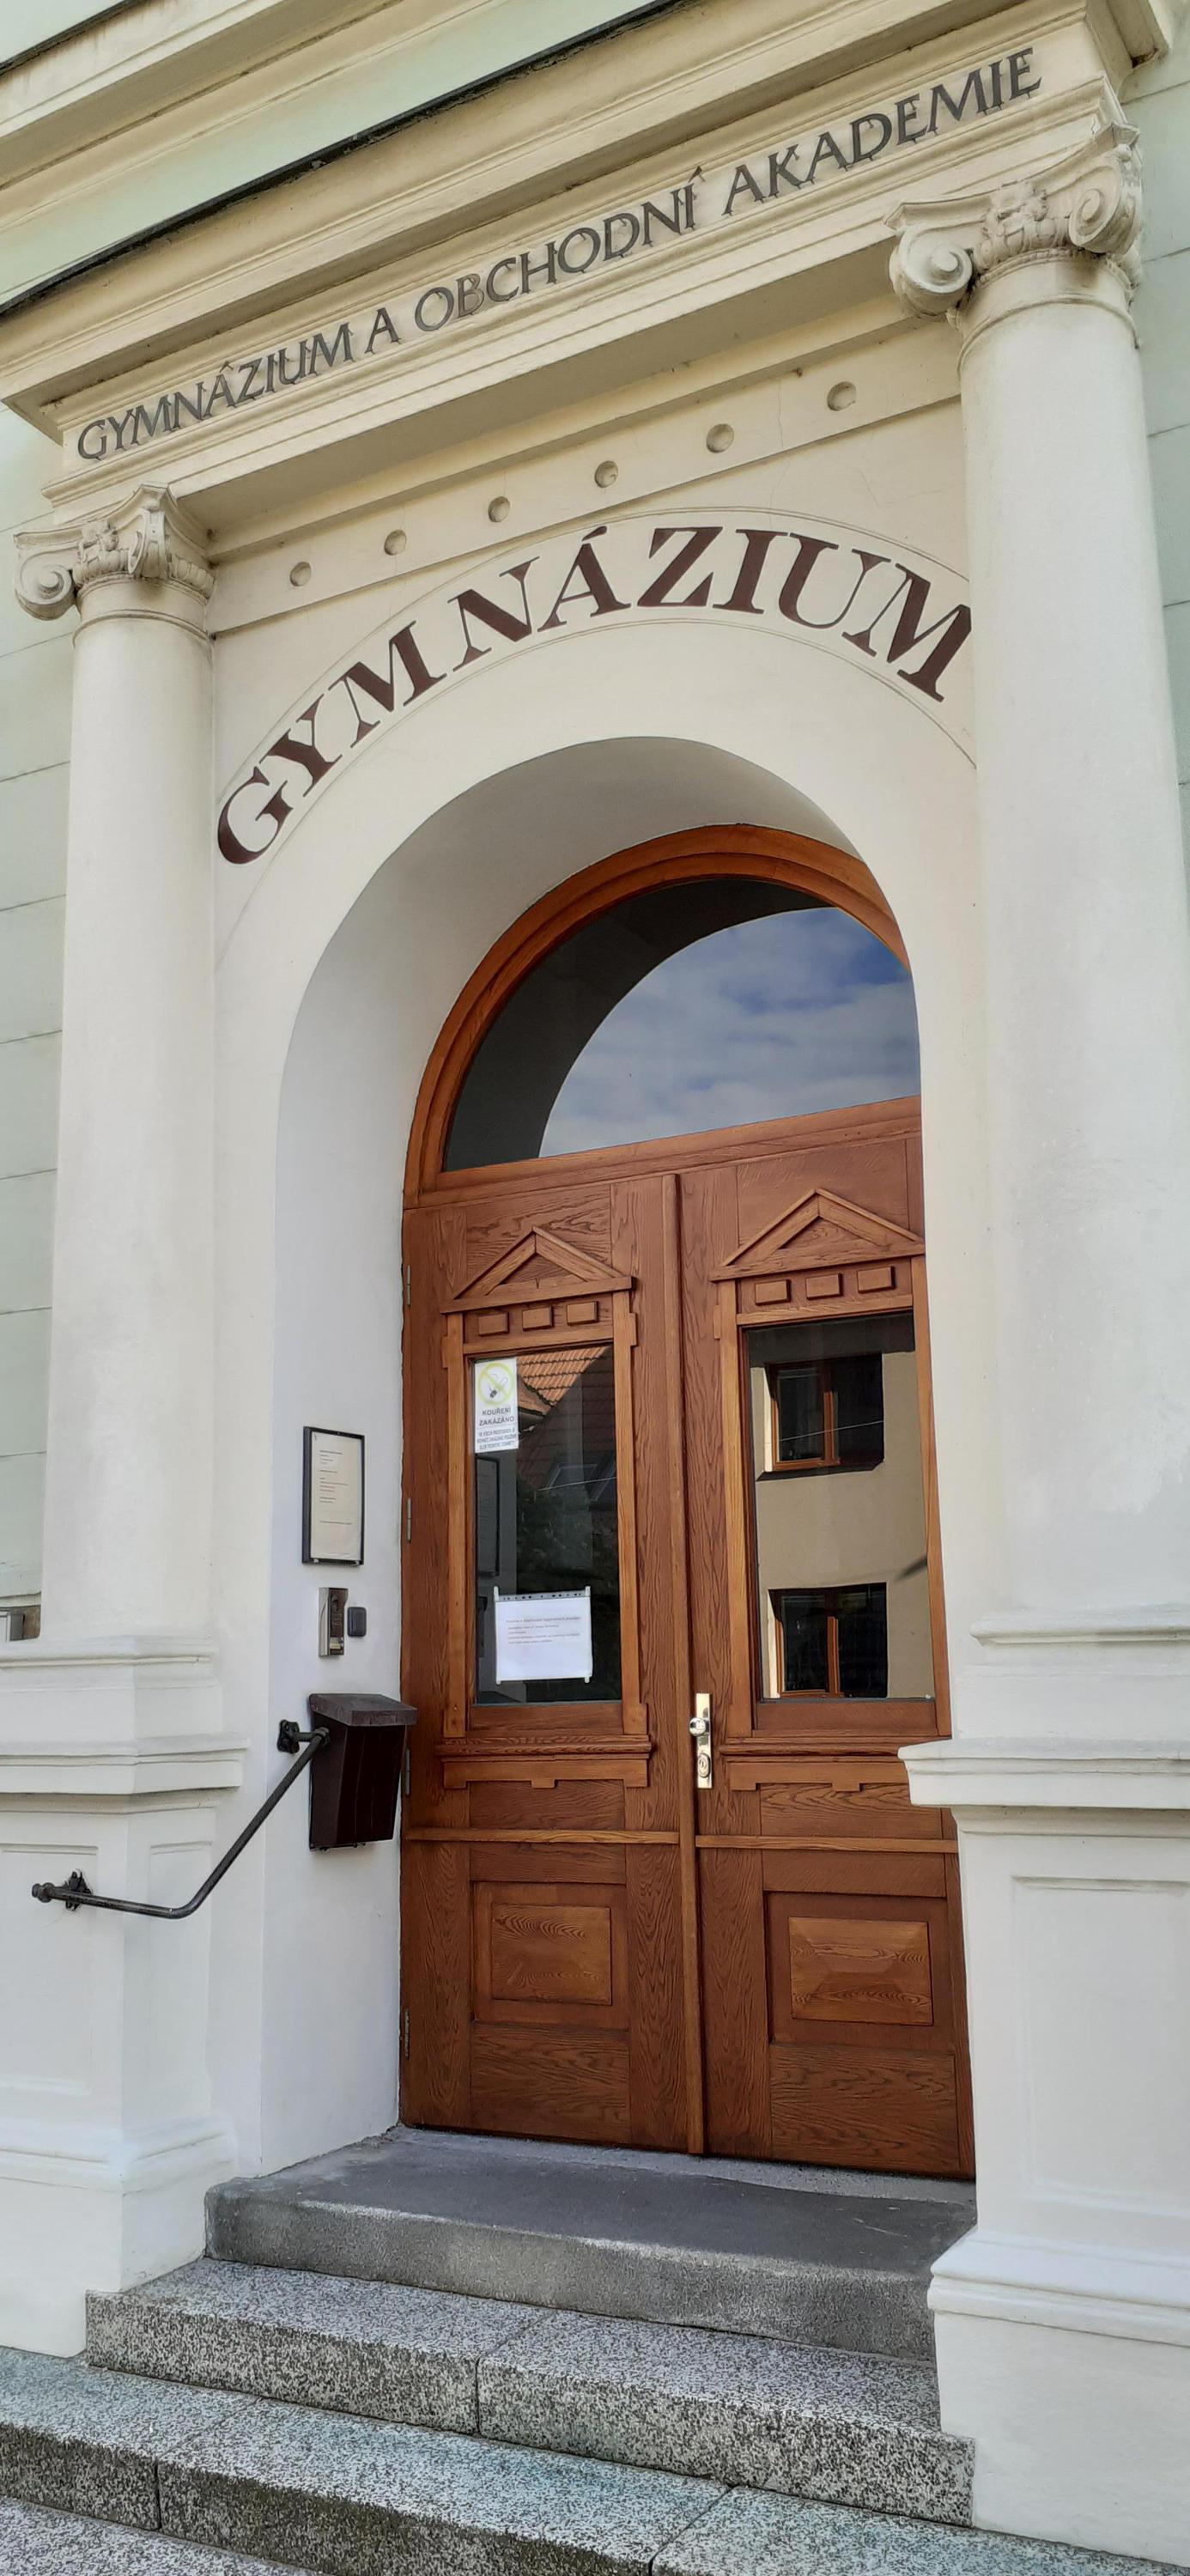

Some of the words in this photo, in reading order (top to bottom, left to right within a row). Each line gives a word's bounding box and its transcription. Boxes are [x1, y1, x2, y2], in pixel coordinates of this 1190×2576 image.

[77, 322, 355, 461] GYMNÁZIUM
[364, 307, 403, 355] A
[414, 166, 706, 332] OBCHODNÍ
[721, 47, 1041, 217] AKADEMIE
[216, 526, 972, 865] GYMNÁZIUM
[479, 1415, 514, 1426] ZAKÁZÁNO
[482, 1406, 512, 1416] KOUŘENÍ
